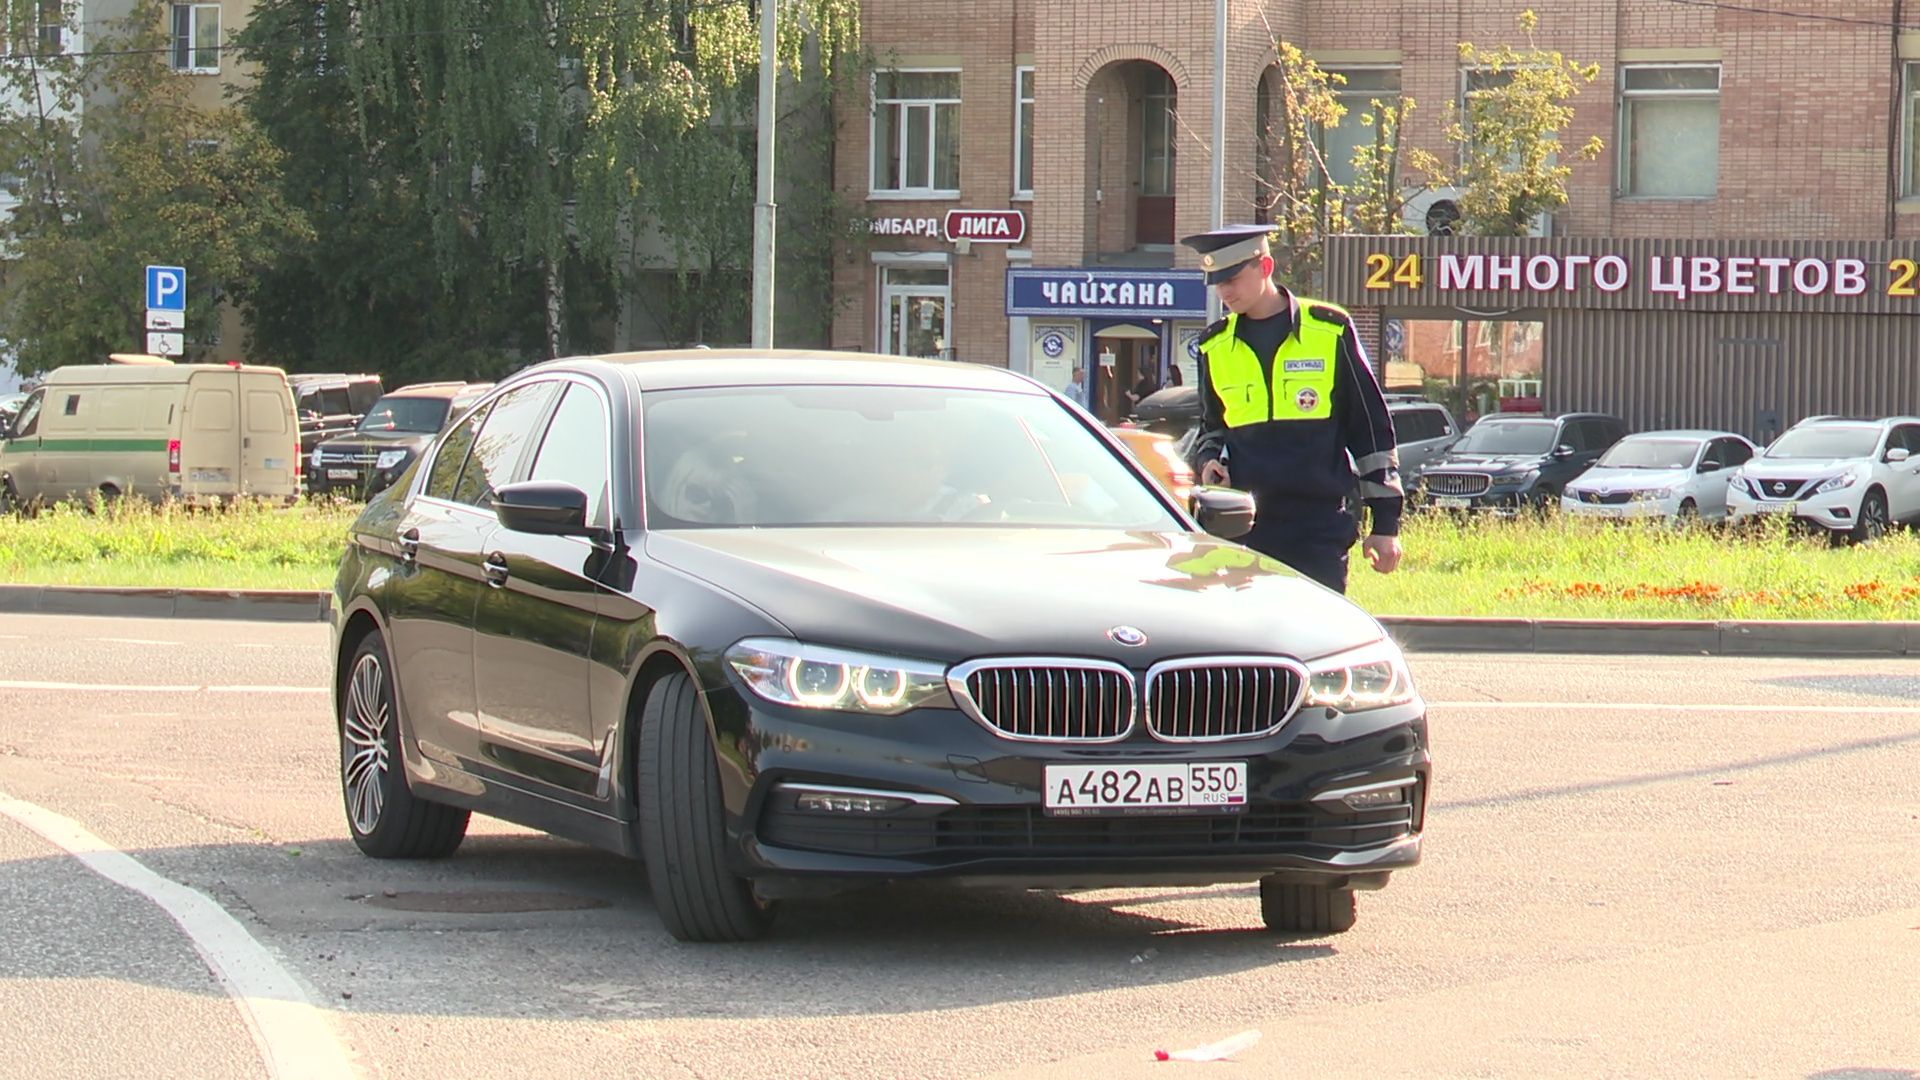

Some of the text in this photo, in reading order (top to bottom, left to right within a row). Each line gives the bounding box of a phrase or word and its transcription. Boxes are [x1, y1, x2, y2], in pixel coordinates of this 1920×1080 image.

[849, 216, 1011, 237] ОМБАРД ЛИГА
[156, 271, 179, 306] P
[1042, 272, 1175, 306] ЧАЙХАНА
[1365, 253, 1920, 300] 24 МНОГО ЦВЕТОВ 2
[1190, 766, 1239, 793] 550
[1202, 792, 1227, 803] RUS
